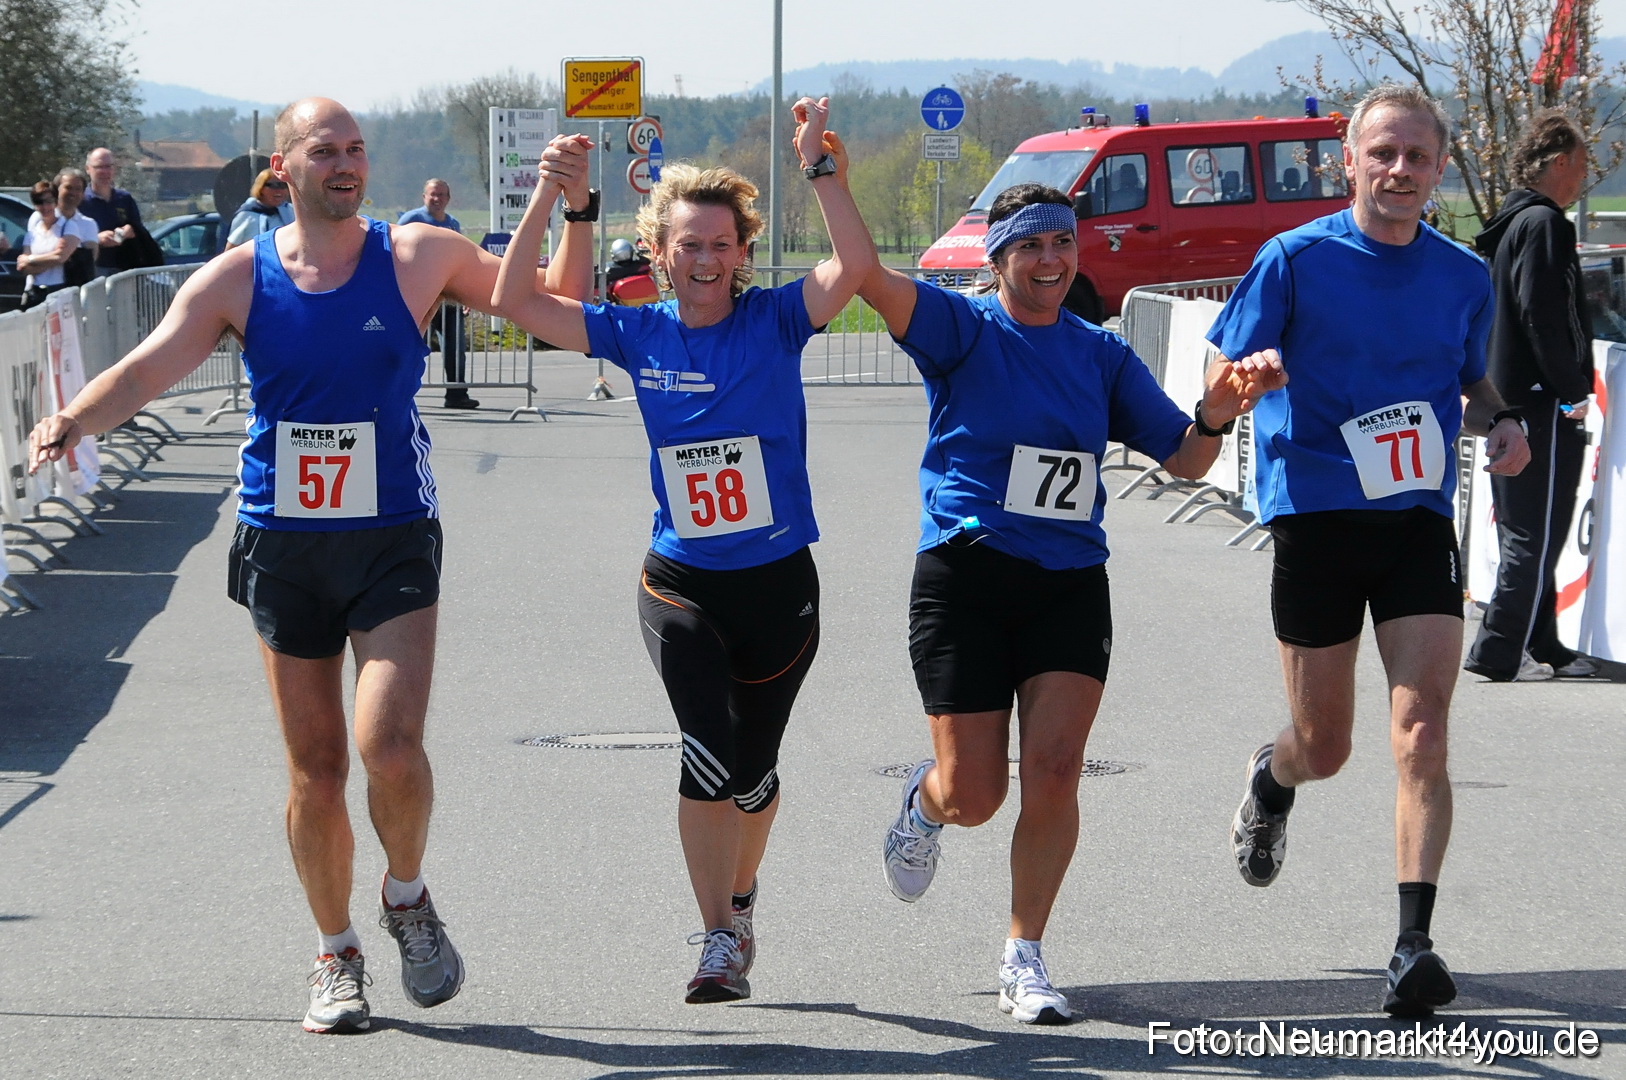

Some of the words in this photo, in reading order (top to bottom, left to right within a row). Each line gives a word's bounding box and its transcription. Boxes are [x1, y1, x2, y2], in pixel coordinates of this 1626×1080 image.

[572, 68, 634, 86] Sengenthal
[599, 87, 625, 97] Anger
[1195, 159, 1212, 175] 60
[506, 194, 527, 208] THULE
[931, 234, 987, 249] EUERWE
[1357, 408, 1403, 428] MEYER
[1360, 418, 1407, 434] WERBUNG
[290, 427, 336, 440] MEYER
[290, 439, 336, 449] WERBUNG
[675, 445, 721, 460] MEYER
[1374, 428, 1425, 482] 77
[677, 457, 723, 468] WERBUNG
[299, 455, 351, 510] 57
[1034, 454, 1082, 511] 72
[685, 468, 749, 528] 58
